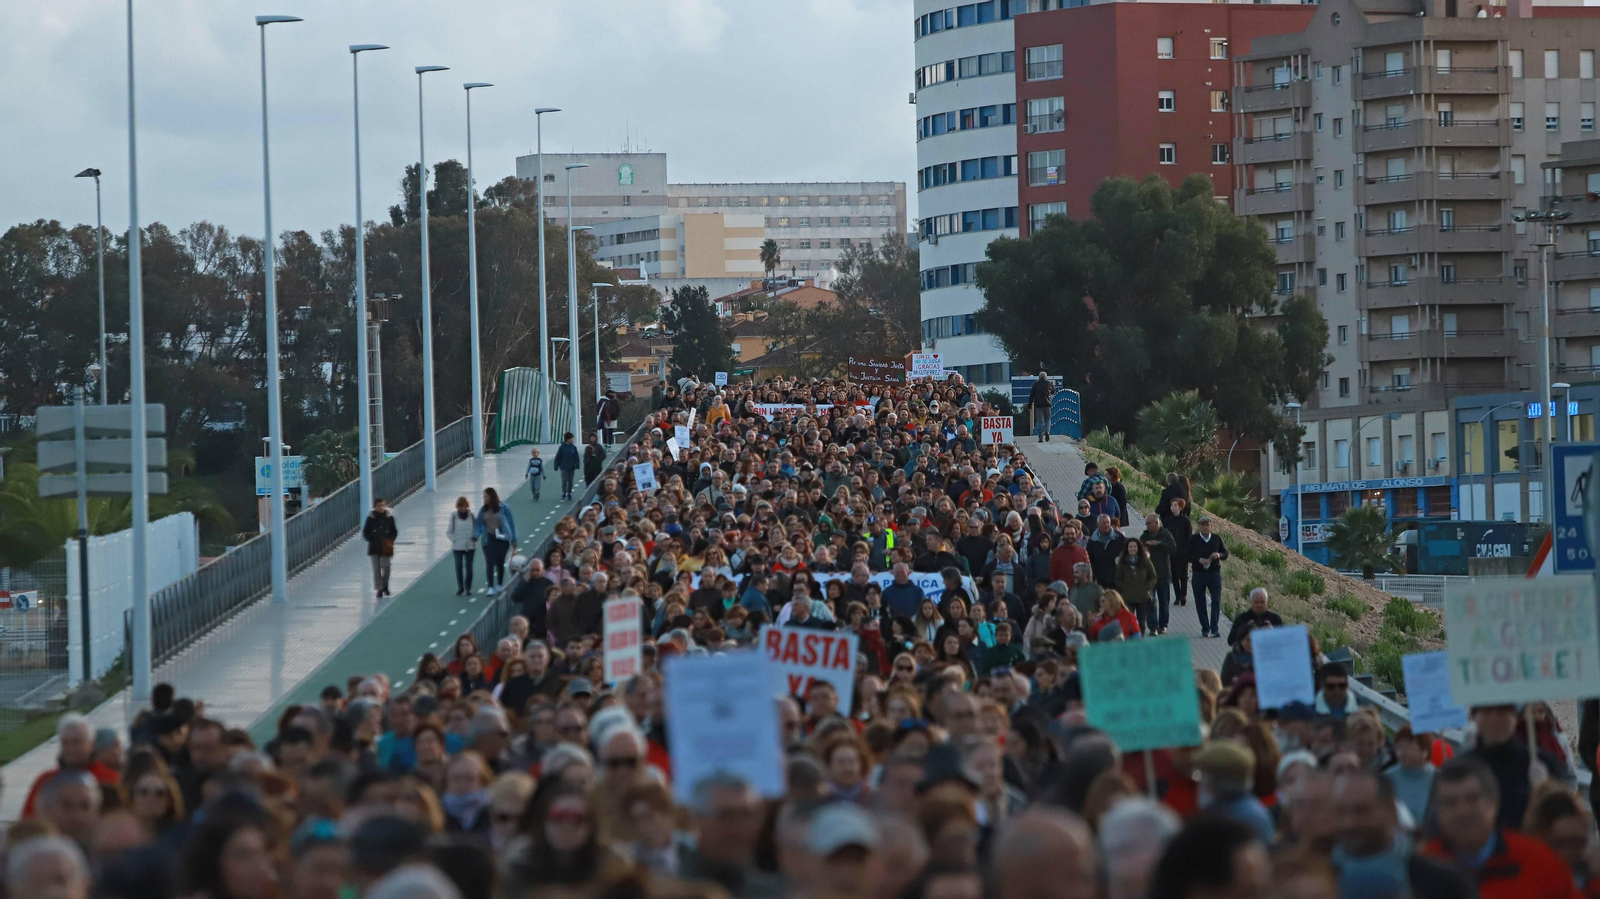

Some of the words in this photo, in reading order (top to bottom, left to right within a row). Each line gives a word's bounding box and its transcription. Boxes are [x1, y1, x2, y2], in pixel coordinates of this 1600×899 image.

[753, 407, 767, 416] SIN
[983, 417, 1012, 430] BASTA
[991, 431, 1003, 443] YA
[1380, 477, 1424, 488] ALONSO
[1557, 526, 1577, 539] 24
[766, 628, 850, 671] BASTA
